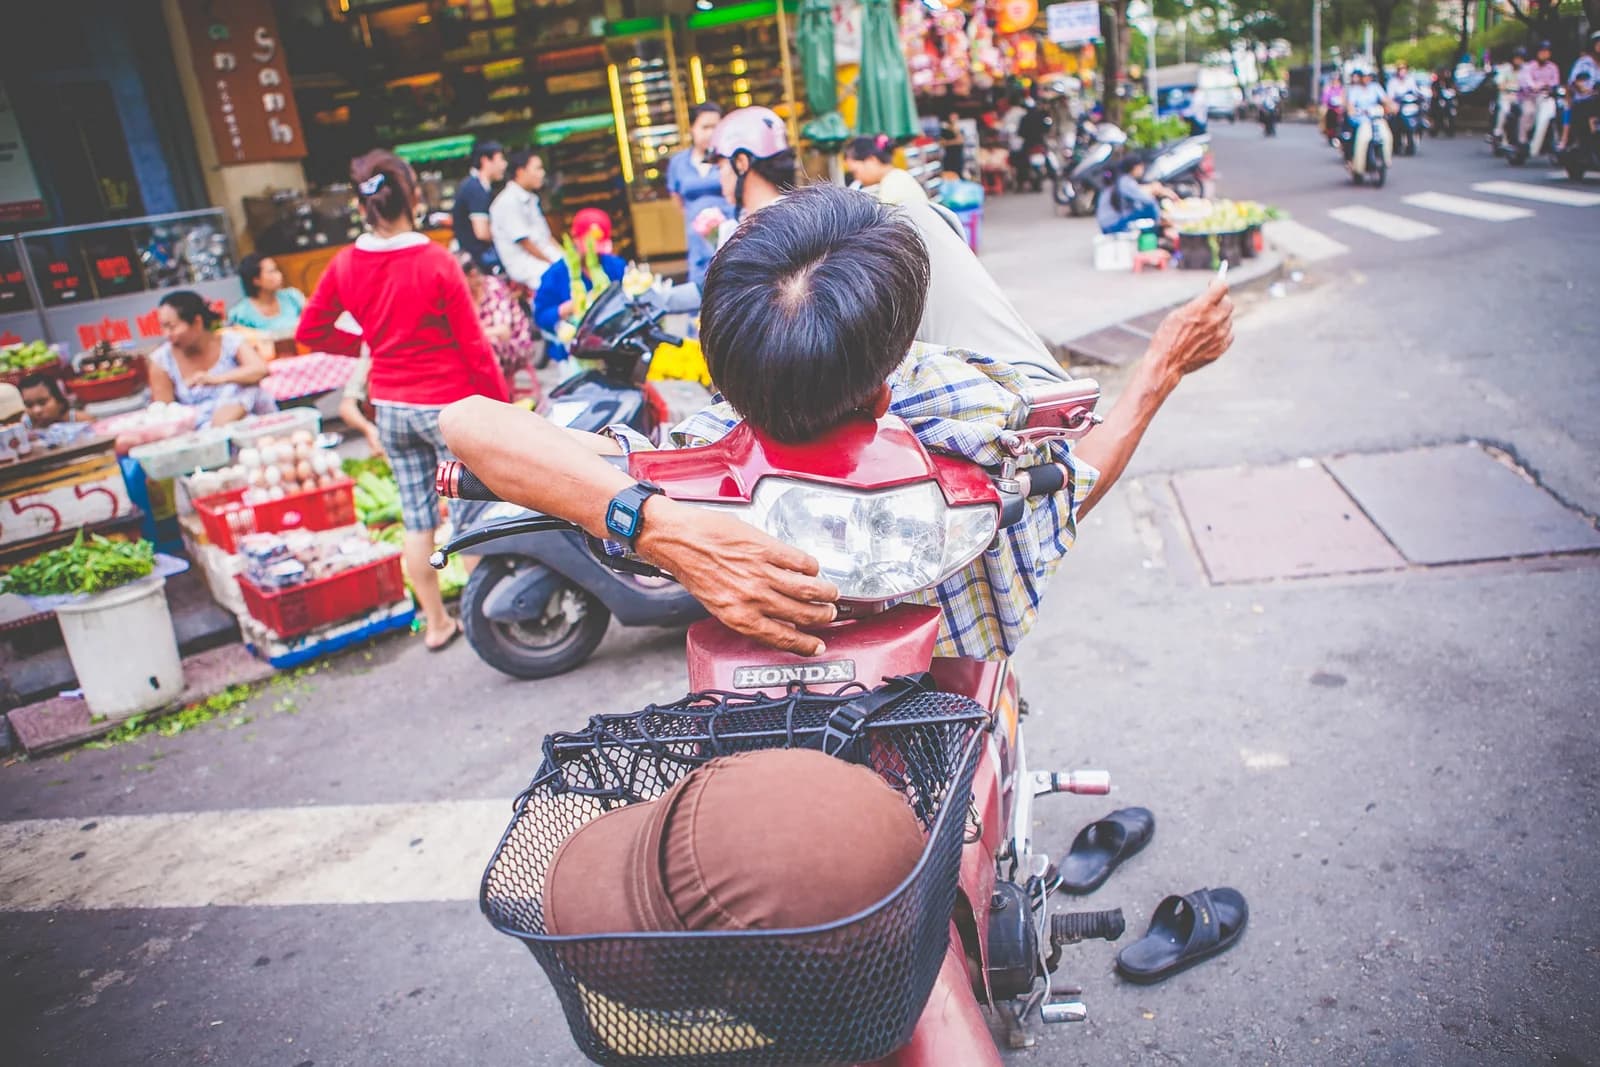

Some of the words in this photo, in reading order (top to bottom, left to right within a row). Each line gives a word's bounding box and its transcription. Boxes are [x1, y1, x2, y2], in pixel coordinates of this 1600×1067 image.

[252, 26, 293, 144] Sanh
[0, 477, 118, 538] 55
[739, 665, 848, 684] HONDA
